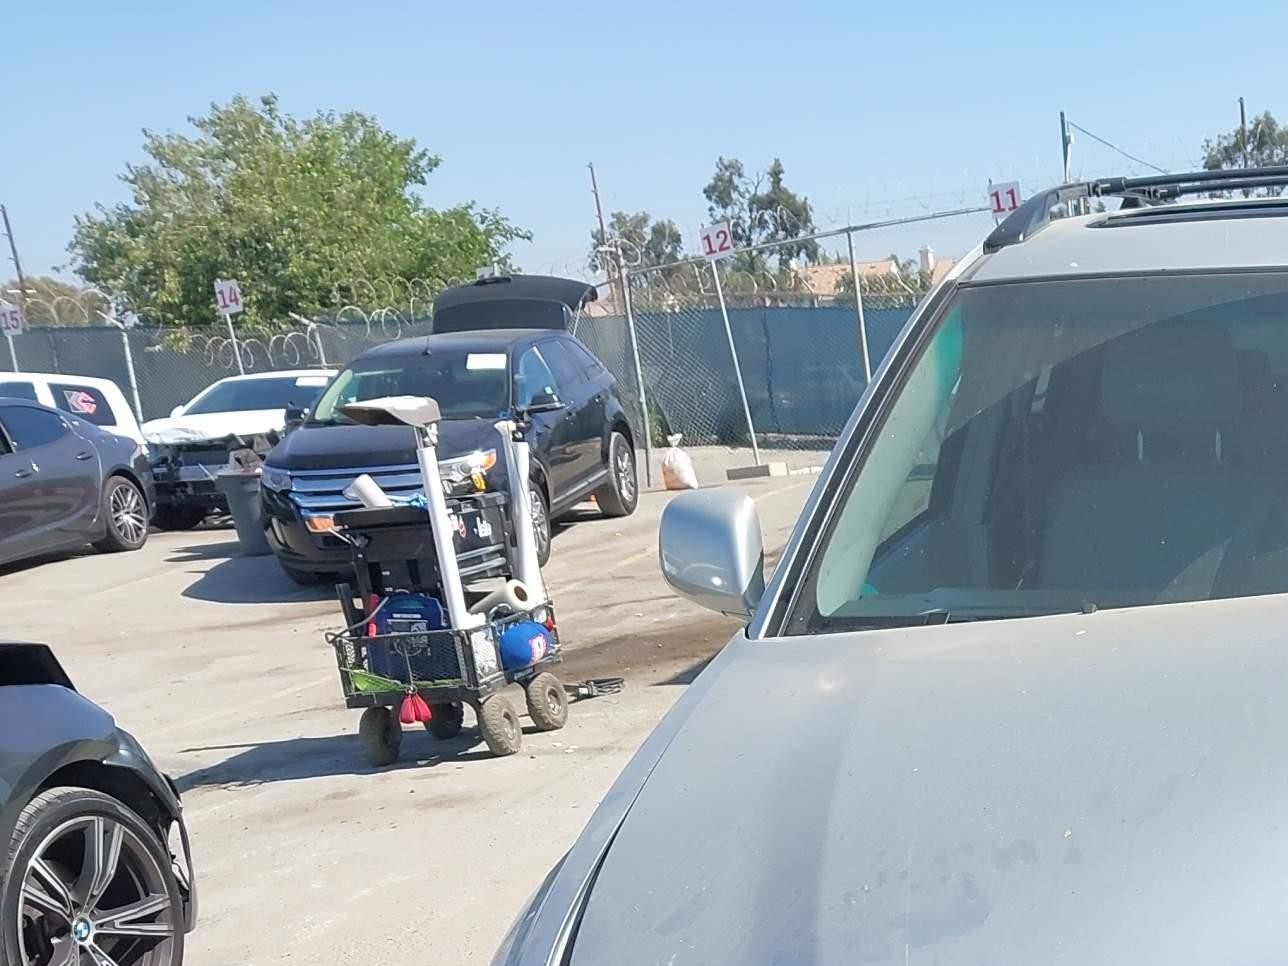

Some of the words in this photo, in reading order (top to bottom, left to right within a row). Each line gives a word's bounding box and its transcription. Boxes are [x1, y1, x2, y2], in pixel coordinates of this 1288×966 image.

[991, 188, 1018, 213] 11
[703, 230, 731, 256] 12
[218, 286, 239, 309] 14
[1, 310, 19, 330] 15
